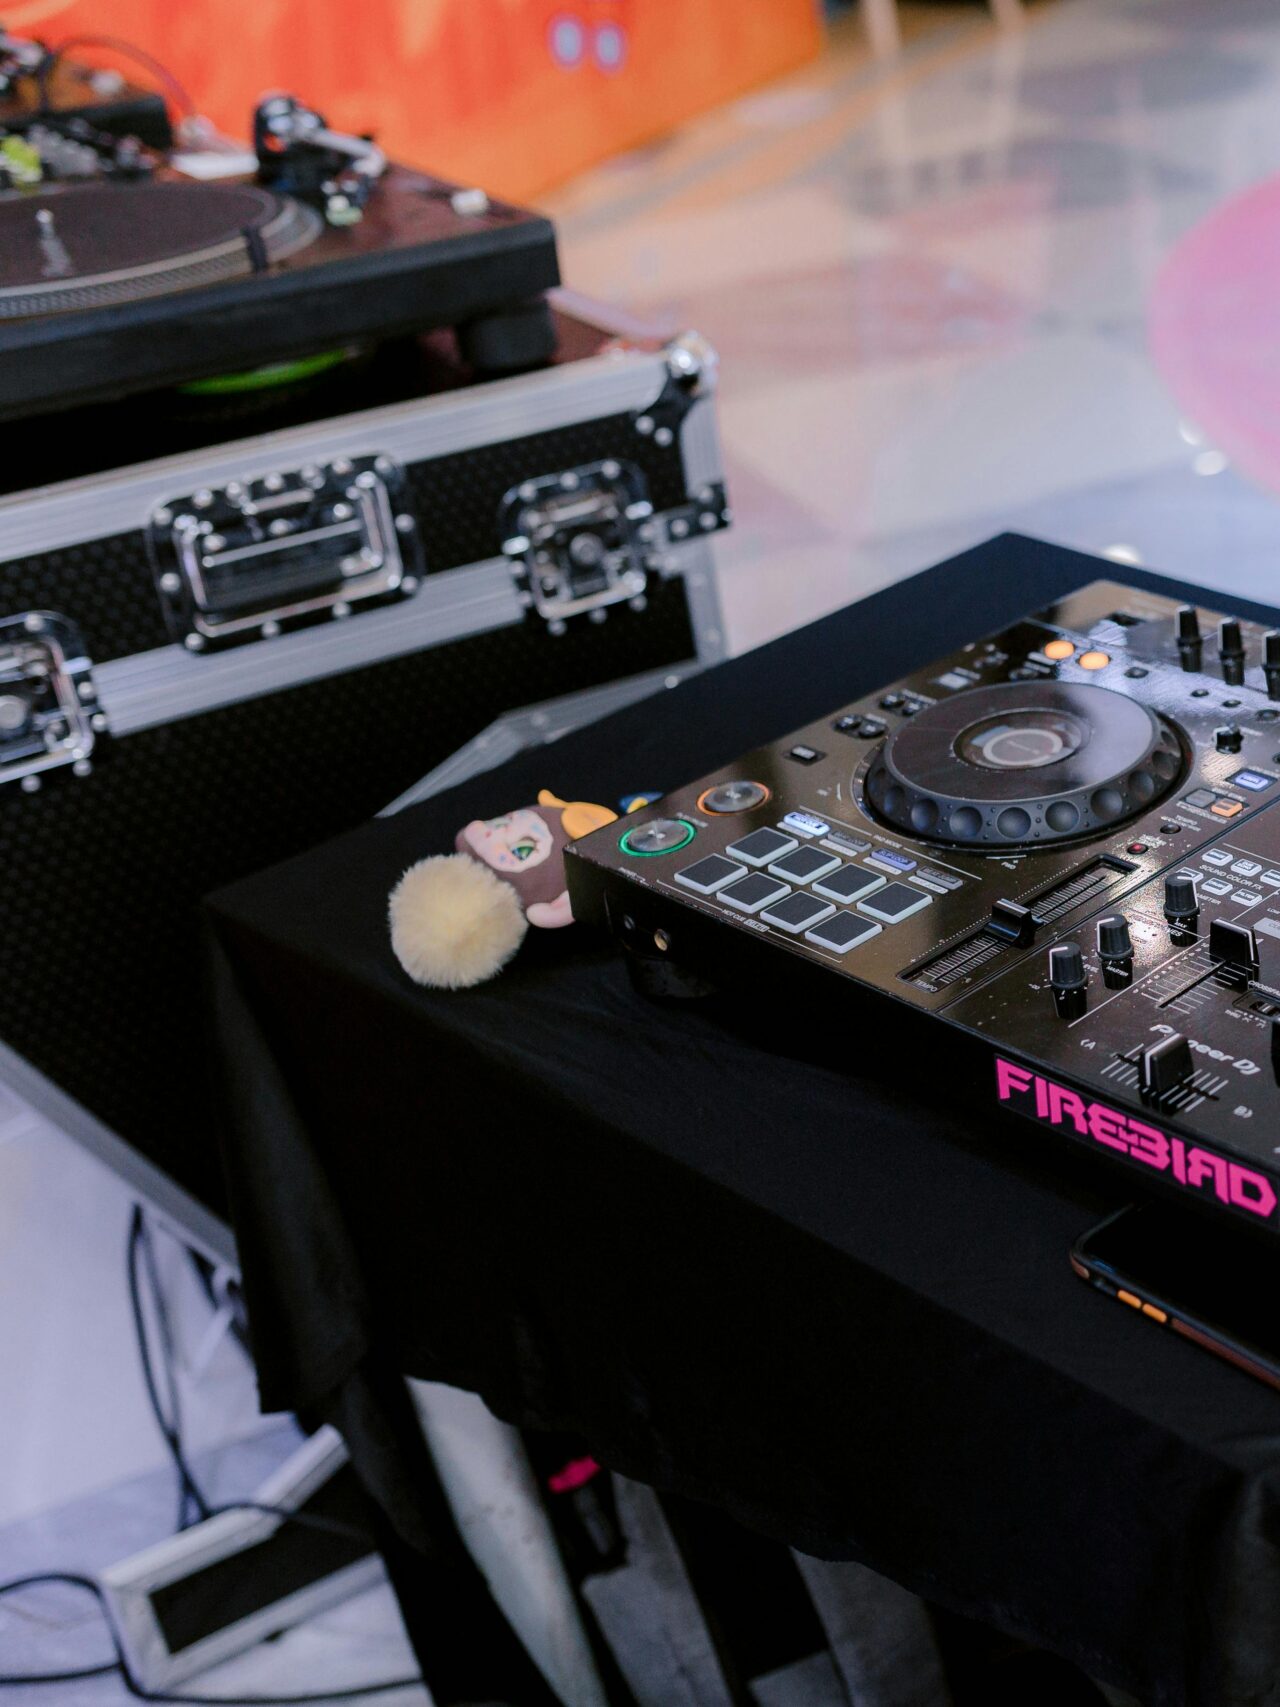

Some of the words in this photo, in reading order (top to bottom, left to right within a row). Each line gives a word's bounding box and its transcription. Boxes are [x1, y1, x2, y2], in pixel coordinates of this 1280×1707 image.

[1200, 864, 1227, 877] SOUND
[1226, 874, 1253, 887] COLOR
[1106, 965, 1129, 977] MASTER
[915, 979, 938, 992] TEMPO
[1150, 1024, 1235, 1063] Pneer
